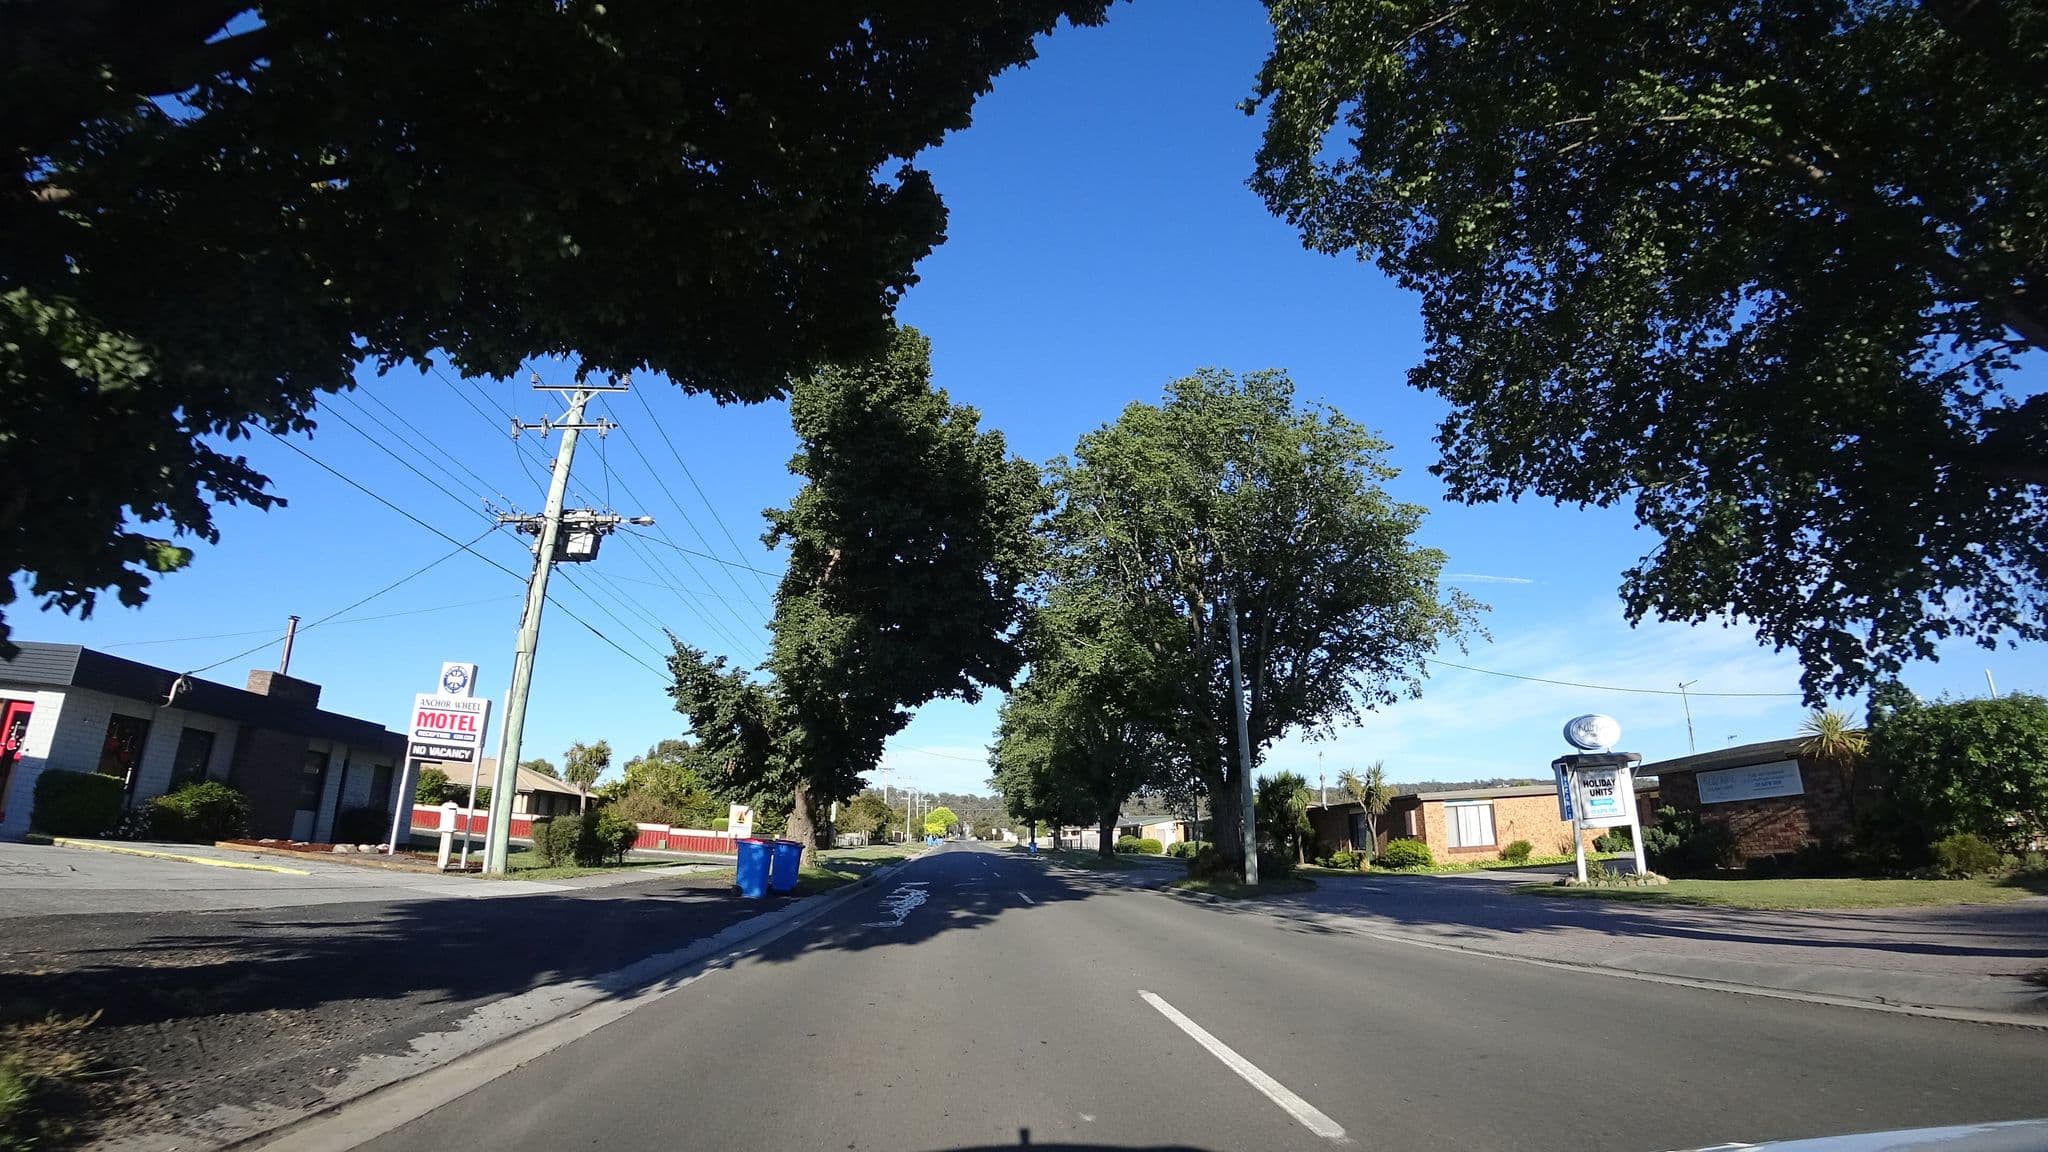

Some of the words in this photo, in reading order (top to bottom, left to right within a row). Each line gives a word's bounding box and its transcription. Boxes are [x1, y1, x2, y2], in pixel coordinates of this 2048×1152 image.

[420, 698, 451, 708] ANCHOR
[455, 702, 481, 711] WHEEL
[417, 711, 477, 731] MOTEL
[412, 745, 427, 755] NO
[429, 746, 472, 759] VACANCY
[1583, 778, 1616, 788] HOLIDAY
[1589, 788, 1613, 797] UNITS
